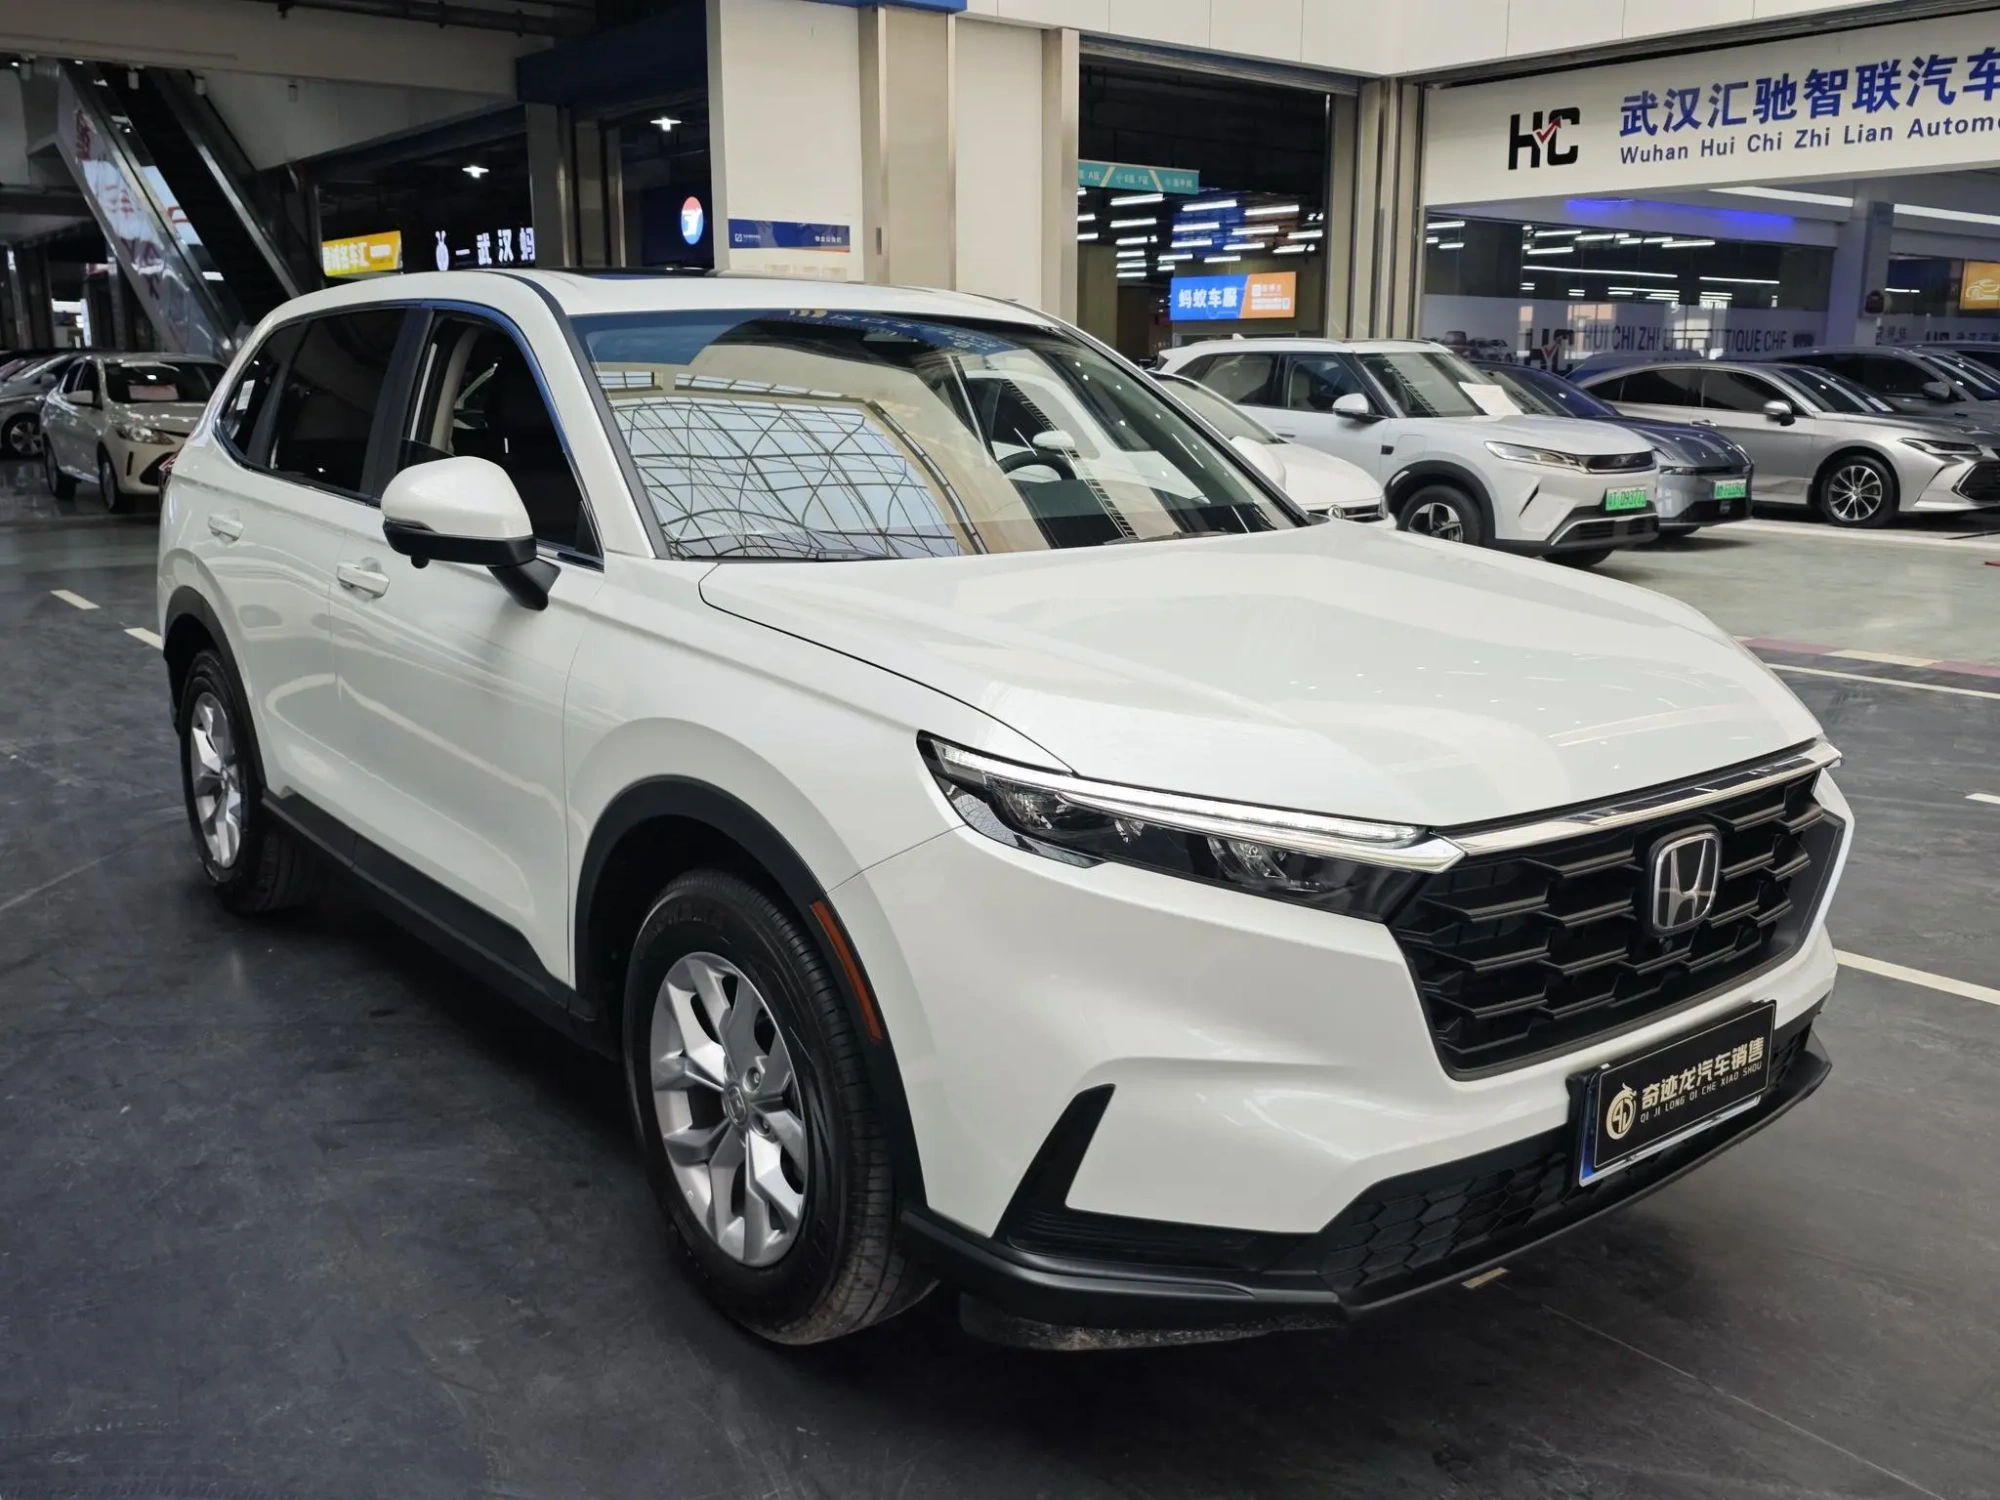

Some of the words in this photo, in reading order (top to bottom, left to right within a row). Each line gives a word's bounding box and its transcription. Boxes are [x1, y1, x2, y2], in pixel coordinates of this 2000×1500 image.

[1620, 144, 1688, 164] Wuhan
[1701, 137, 1734, 157] Hui
[1747, 131, 1782, 152] Chi
[1794, 127, 1830, 149] Zhi
[1844, 124, 1893, 144] Lian
[1906, 115, 2000, 139] Autom
